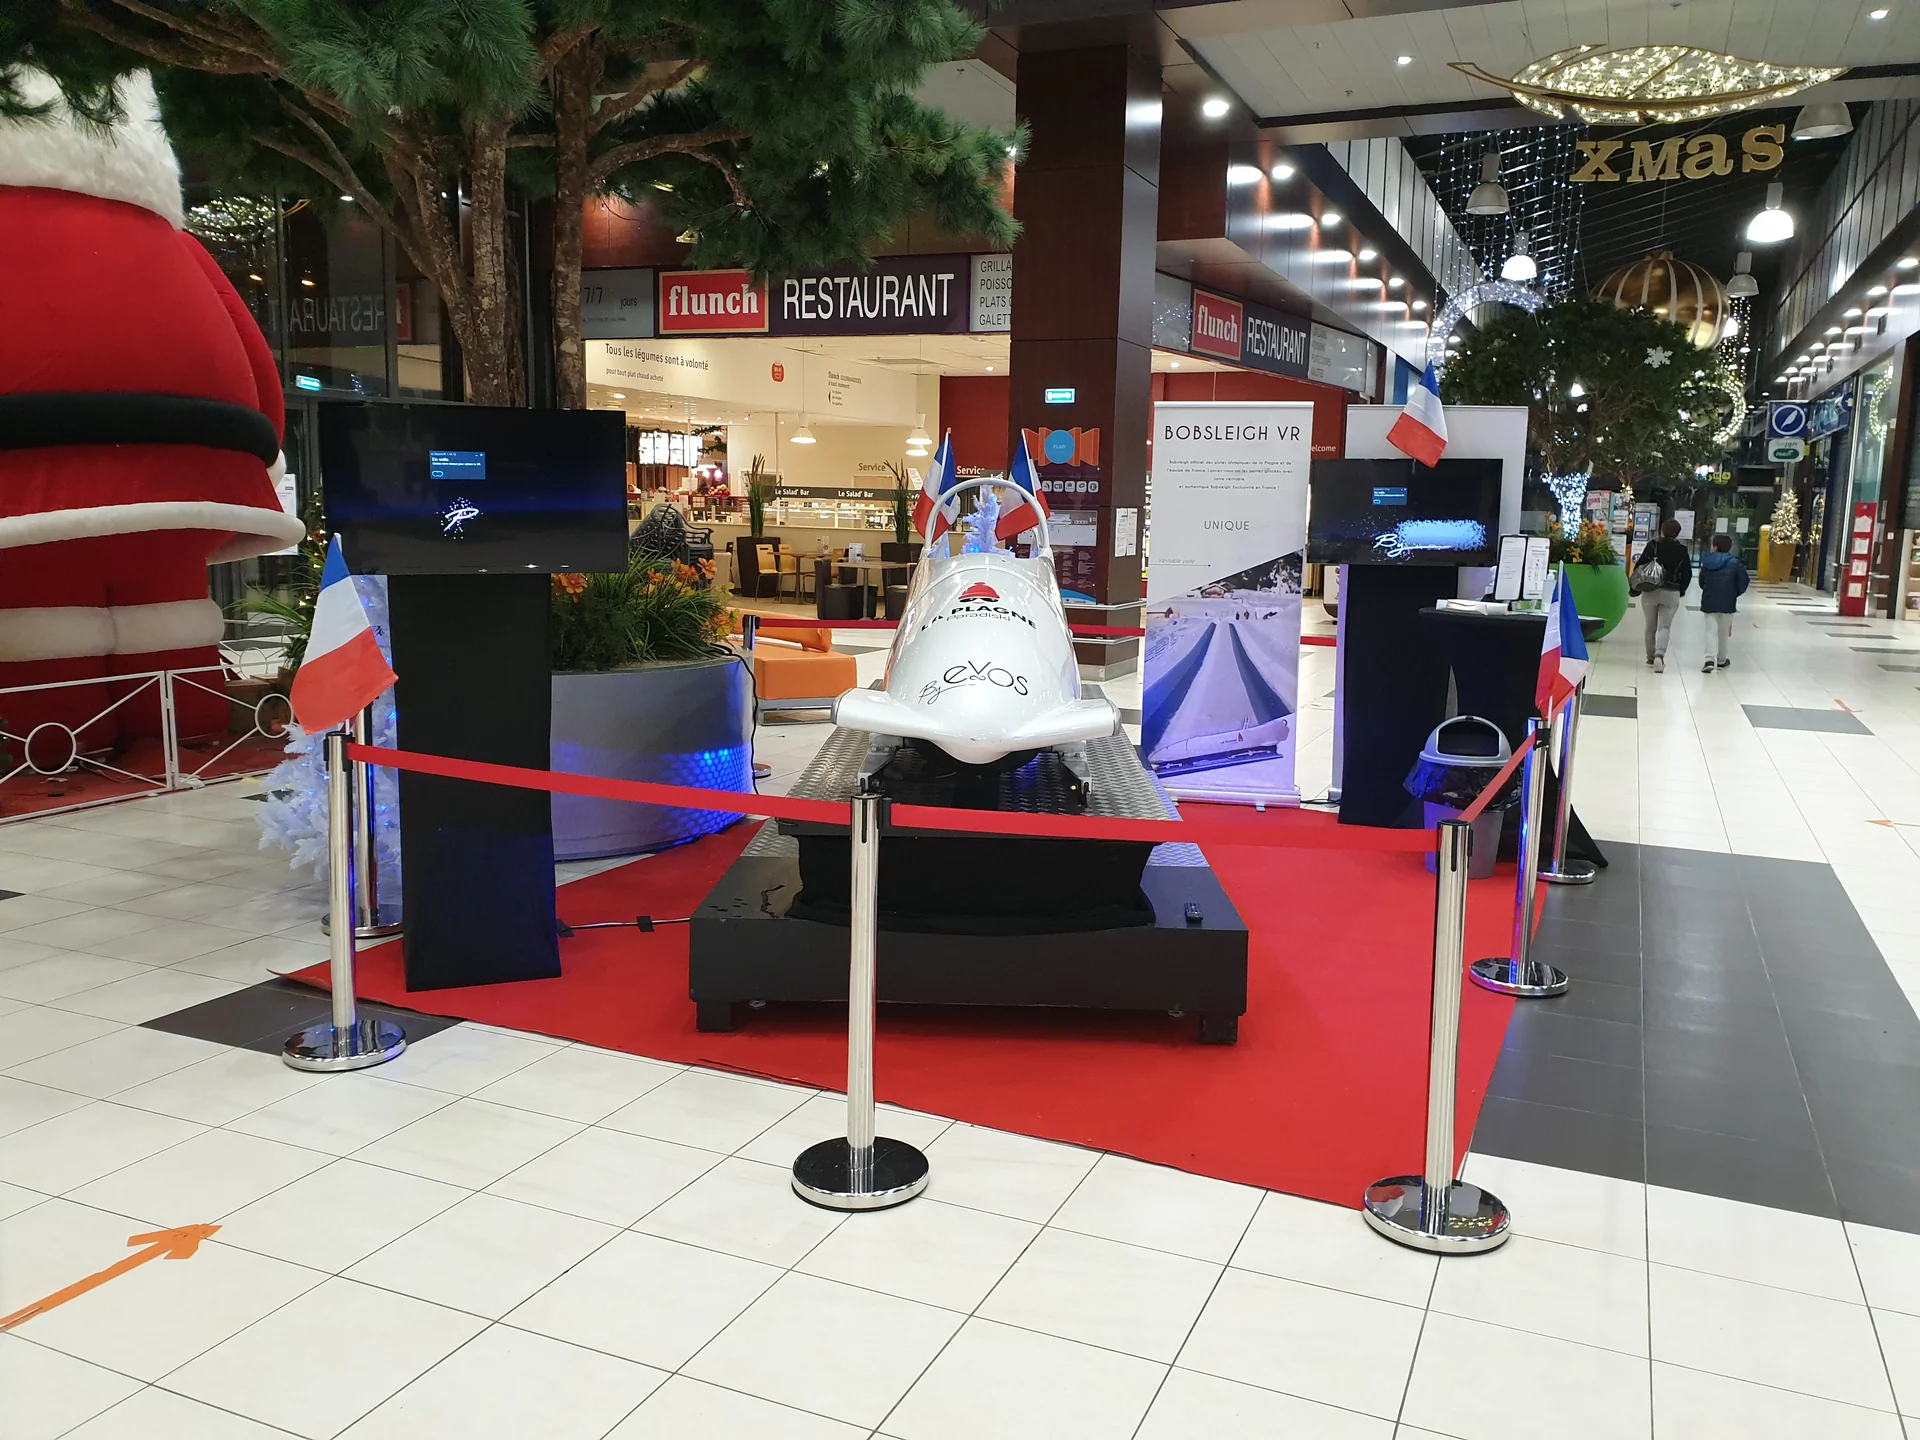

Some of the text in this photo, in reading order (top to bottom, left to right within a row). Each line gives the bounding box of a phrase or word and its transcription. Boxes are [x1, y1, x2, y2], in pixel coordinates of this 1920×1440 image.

[980, 260, 1013, 273] GRILLA
[980, 277, 1013, 290] POISSO
[583, 287, 638, 310] 7/7 jours
[668, 283, 759, 316] flunch
[783, 273, 955, 320] RESTAURANT
[979, 295, 1007, 308] PLATS
[1197, 304, 1238, 344] flunch
[1246, 316, 1307, 366] RESTAURANT
[605, 342, 709, 371] Tous les légumes sont à volonté
[605, 367, 617, 375] pour
[617, 369, 627, 377] tout
[627, 370, 637, 378] plat
[636, 371, 650, 380] chaud
[1164, 425, 1301, 442] BOBSLEIGH VR
[1311, 444, 1337, 453] elcome
[858, 462, 886, 472] Service
[956, 465, 985, 475] Servic
[1203, 520, 1250, 532] UNIQUE
[951, 605, 1037, 630] PLAGNE
